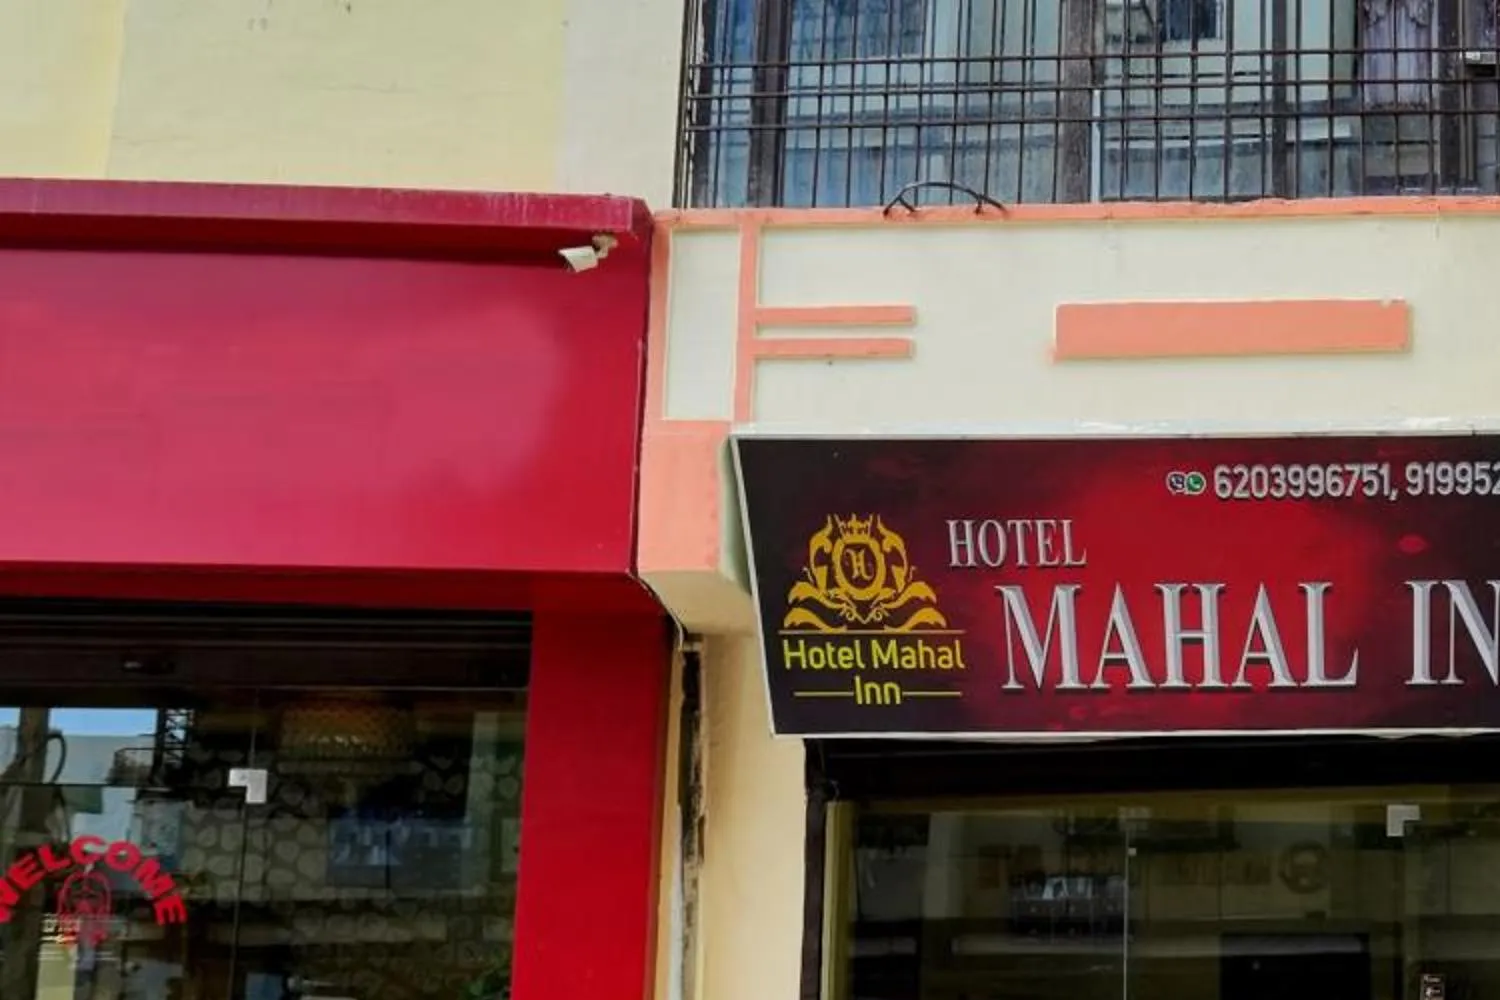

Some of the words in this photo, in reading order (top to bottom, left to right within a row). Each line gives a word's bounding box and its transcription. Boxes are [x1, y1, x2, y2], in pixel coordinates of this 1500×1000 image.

[1214, 463, 1398, 500] 6203996751,
[946, 519, 1087, 568] HOTEL
[994, 581, 1360, 690] MAHAL
[782, 639, 866, 670] Hotel
[871, 639, 966, 670] Mahal
[854, 675, 902, 706] Inn
